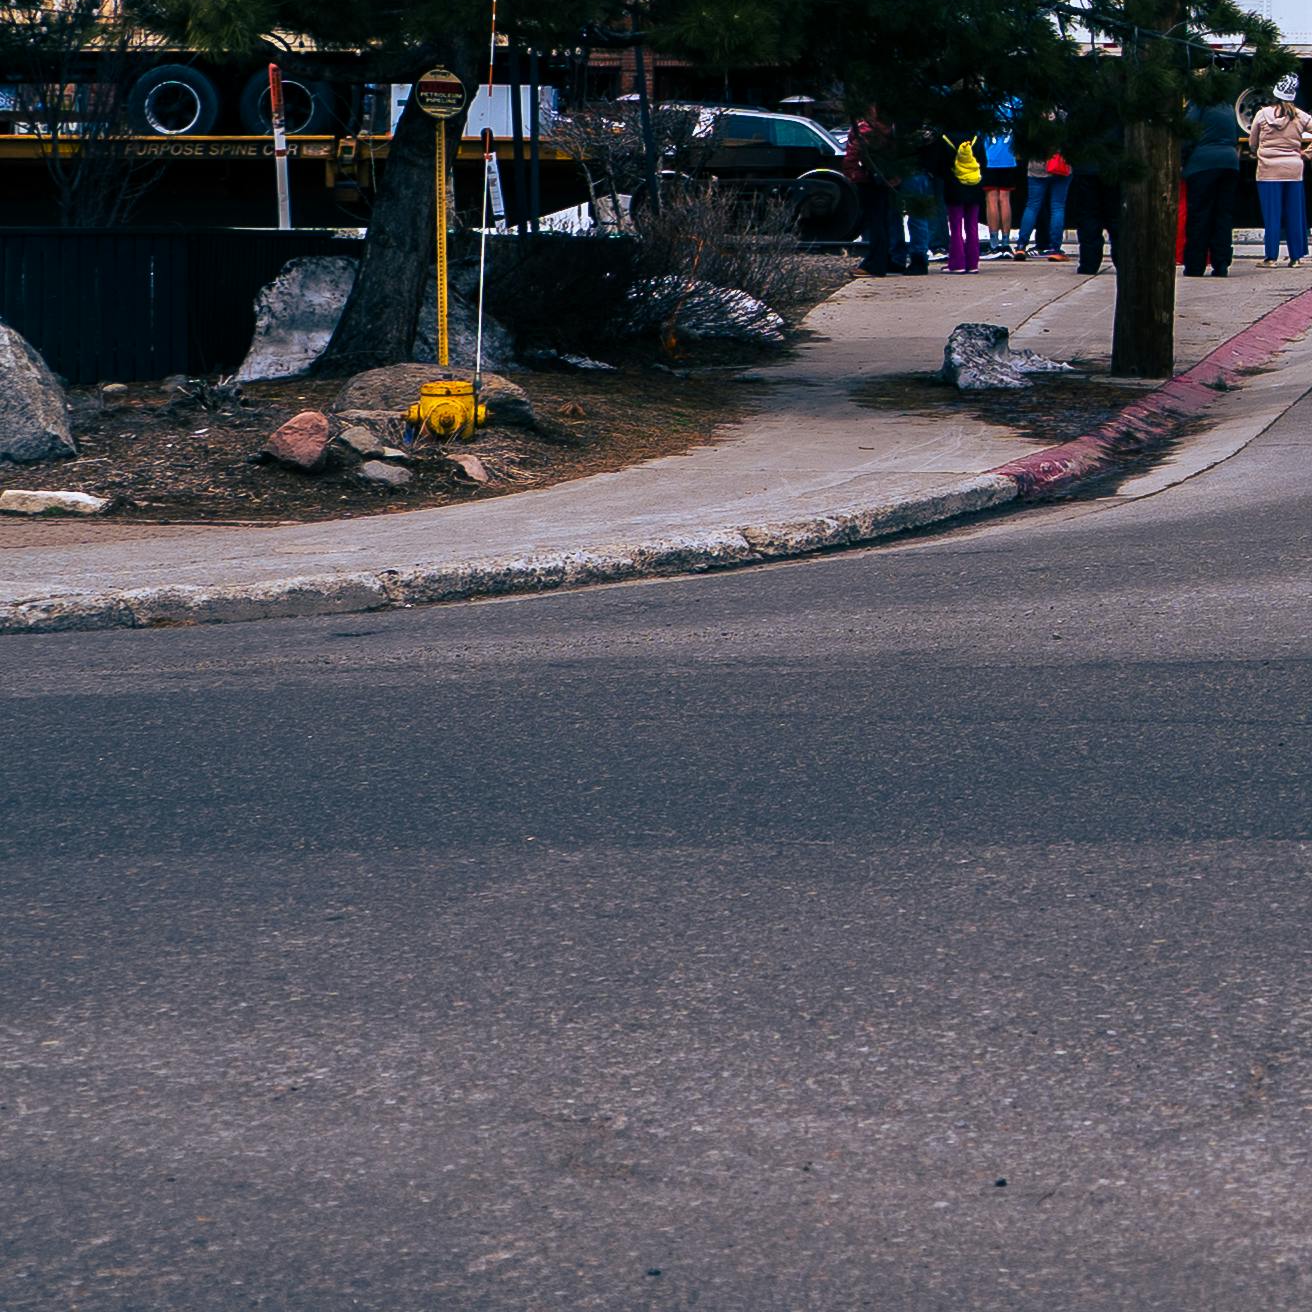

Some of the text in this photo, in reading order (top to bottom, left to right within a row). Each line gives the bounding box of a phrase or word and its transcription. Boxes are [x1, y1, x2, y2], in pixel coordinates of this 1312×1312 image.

[124, 142, 204, 156] PURPOSE
[208, 142, 258, 156] SPINE
[263, 143, 298, 156] CR
